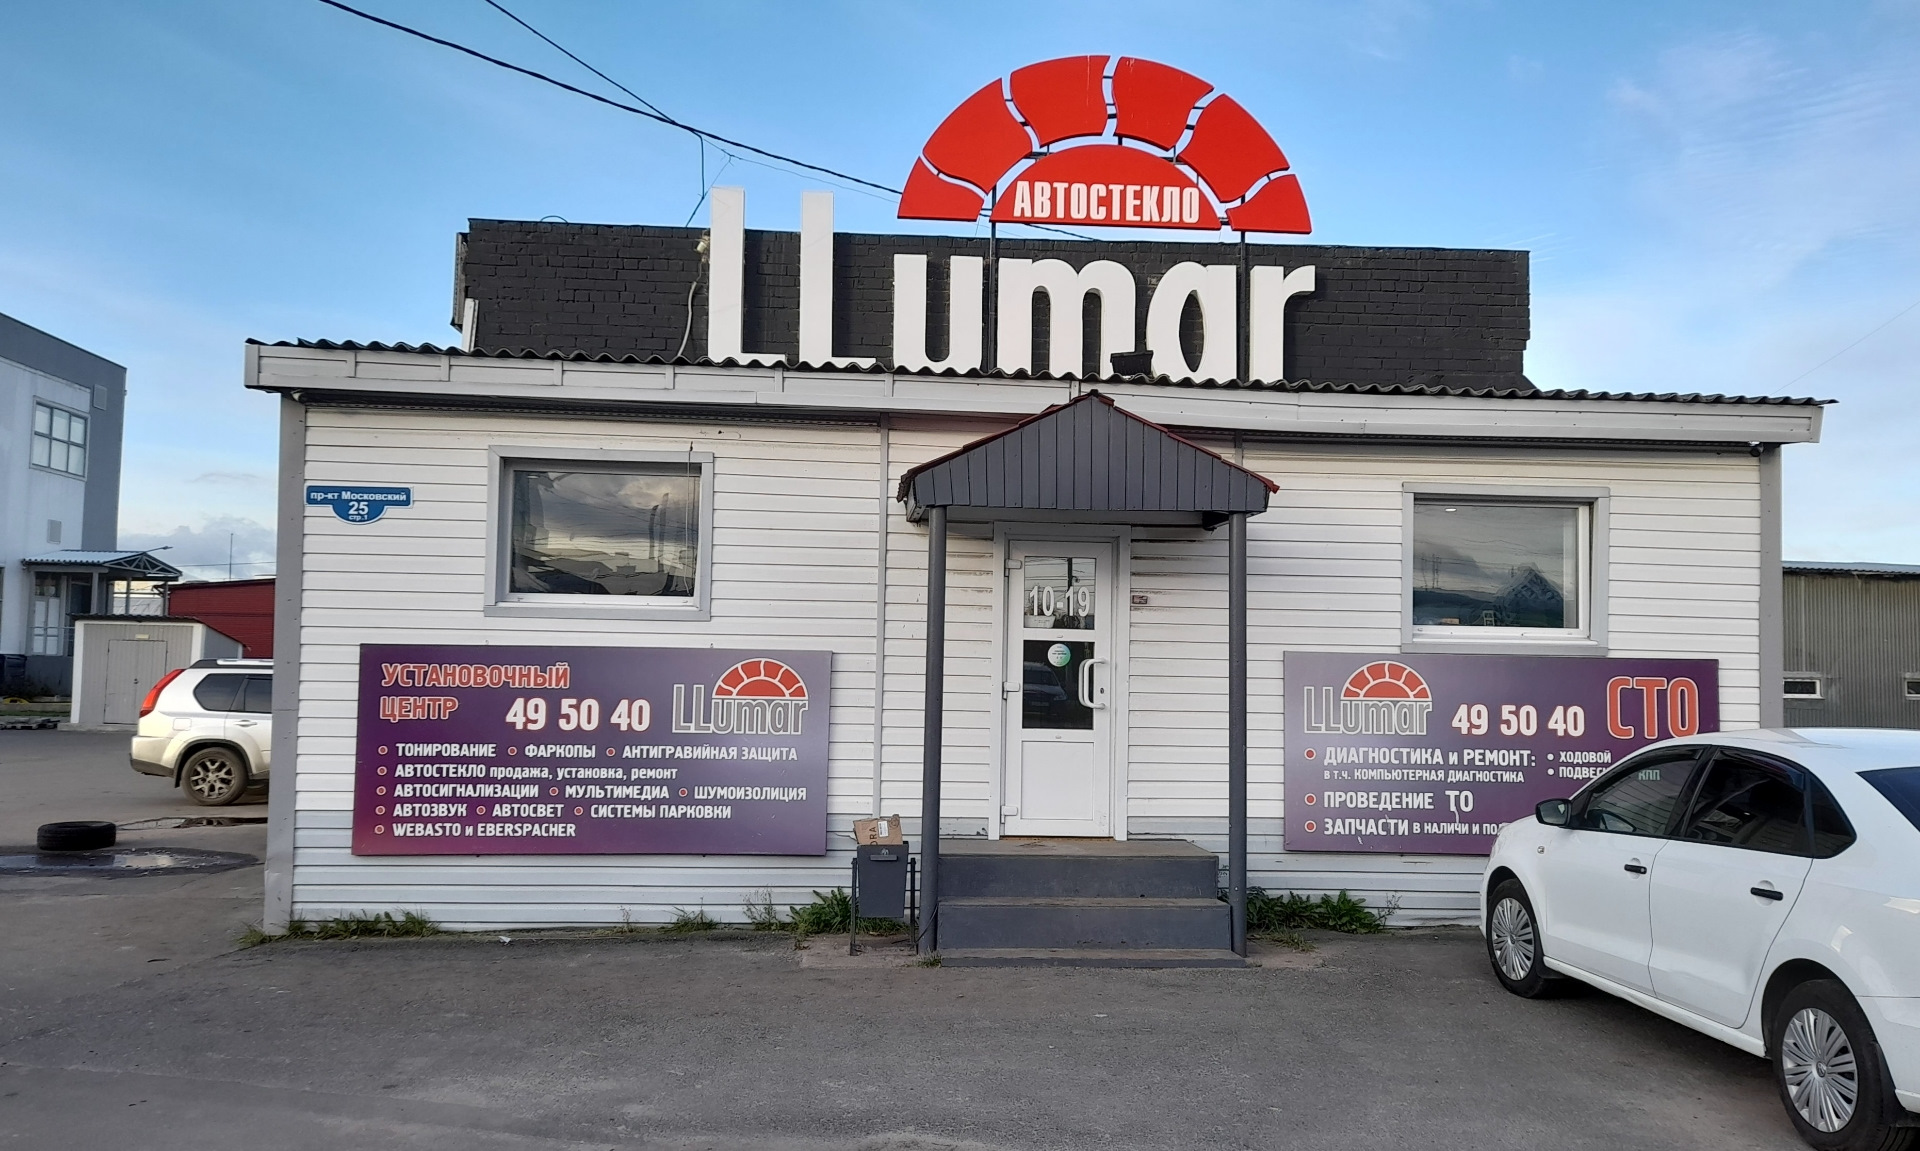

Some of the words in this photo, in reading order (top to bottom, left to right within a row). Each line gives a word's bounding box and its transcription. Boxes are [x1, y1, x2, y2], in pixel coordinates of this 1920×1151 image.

[1013, 180, 1200, 223] АВТОСТЕКЛО
[707, 187, 1317, 384] LLumar
[310, 492, 339, 501] пр-кт
[341, 491, 407, 501] Московский
[348, 501, 369, 515] 25
[1029, 585, 1090, 617] 10-19
[381, 662, 571, 689] УСТАНОВОЧНЫЙ
[379, 696, 459, 723] ЦЕНТР
[505, 697, 547, 731] 49
[557, 698, 600, 732] 50
[610, 699, 651, 732] 40
[672, 684, 809, 735] LLumar
[1304, 686, 1433, 735] LLumar
[1607, 676, 1699, 739] СТО
[1452, 704, 1489, 735] 49
[1500, 705, 1537, 736] 50
[1548, 706, 1585, 737] 40
[396, 743, 497, 757] ТОНИРОВАНИЕ
[524, 744, 596, 758] ФАРКОПЫ
[622, 744, 738, 760] АНТИГРАВИЙНАЯ
[741, 747, 798, 762] ЗАЩИТА
[1324, 747, 1444, 766] ДИАГНОСТИКА
[1449, 752, 1458, 765] и
[1463, 749, 1536, 767] РЕМОНТ:
[1559, 751, 1611, 764] ХОДОВОЙ
[394, 764, 486, 778] АВТОСТЕКЛО
[489, 767, 553, 781] продажа,
[556, 767, 627, 780] установка,
[630, 768, 678, 781] ремонт
[1354, 769, 1445, 781] КОМПЬЮТЕРНАЯ
[1447, 770, 1524, 783] ДИАГНОСТИКА
[1638, 770, 1660, 780] КПП
[393, 784, 539, 799] АВТОСИГНАЛИЗАЦИИ
[565, 785, 669, 800] МУЛЬТИМЕДИА
[694, 786, 807, 802] ШУМОИЗОЛИЦИЯ
[1324, 791, 1434, 811] ПРОВЕДЕНИЕ
[1445, 790, 1474, 812] ТО
[393, 803, 468, 817] АВТОЗВУК
[492, 804, 564, 817] АВТОСВЕТ
[591, 804, 655, 818] СИСТЕМЫ
[659, 805, 732, 819] ПАРКОВКИ
[392, 823, 461, 837] WEBASTO
[465, 826, 474, 836] и
[477, 824, 576, 837] EBERSPACHER
[1324, 818, 1409, 835] ЗАПЧАСТИ
[1424, 822, 1469, 835] НАЛИЧИ
[1482, 823, 1500, 836] ПО
